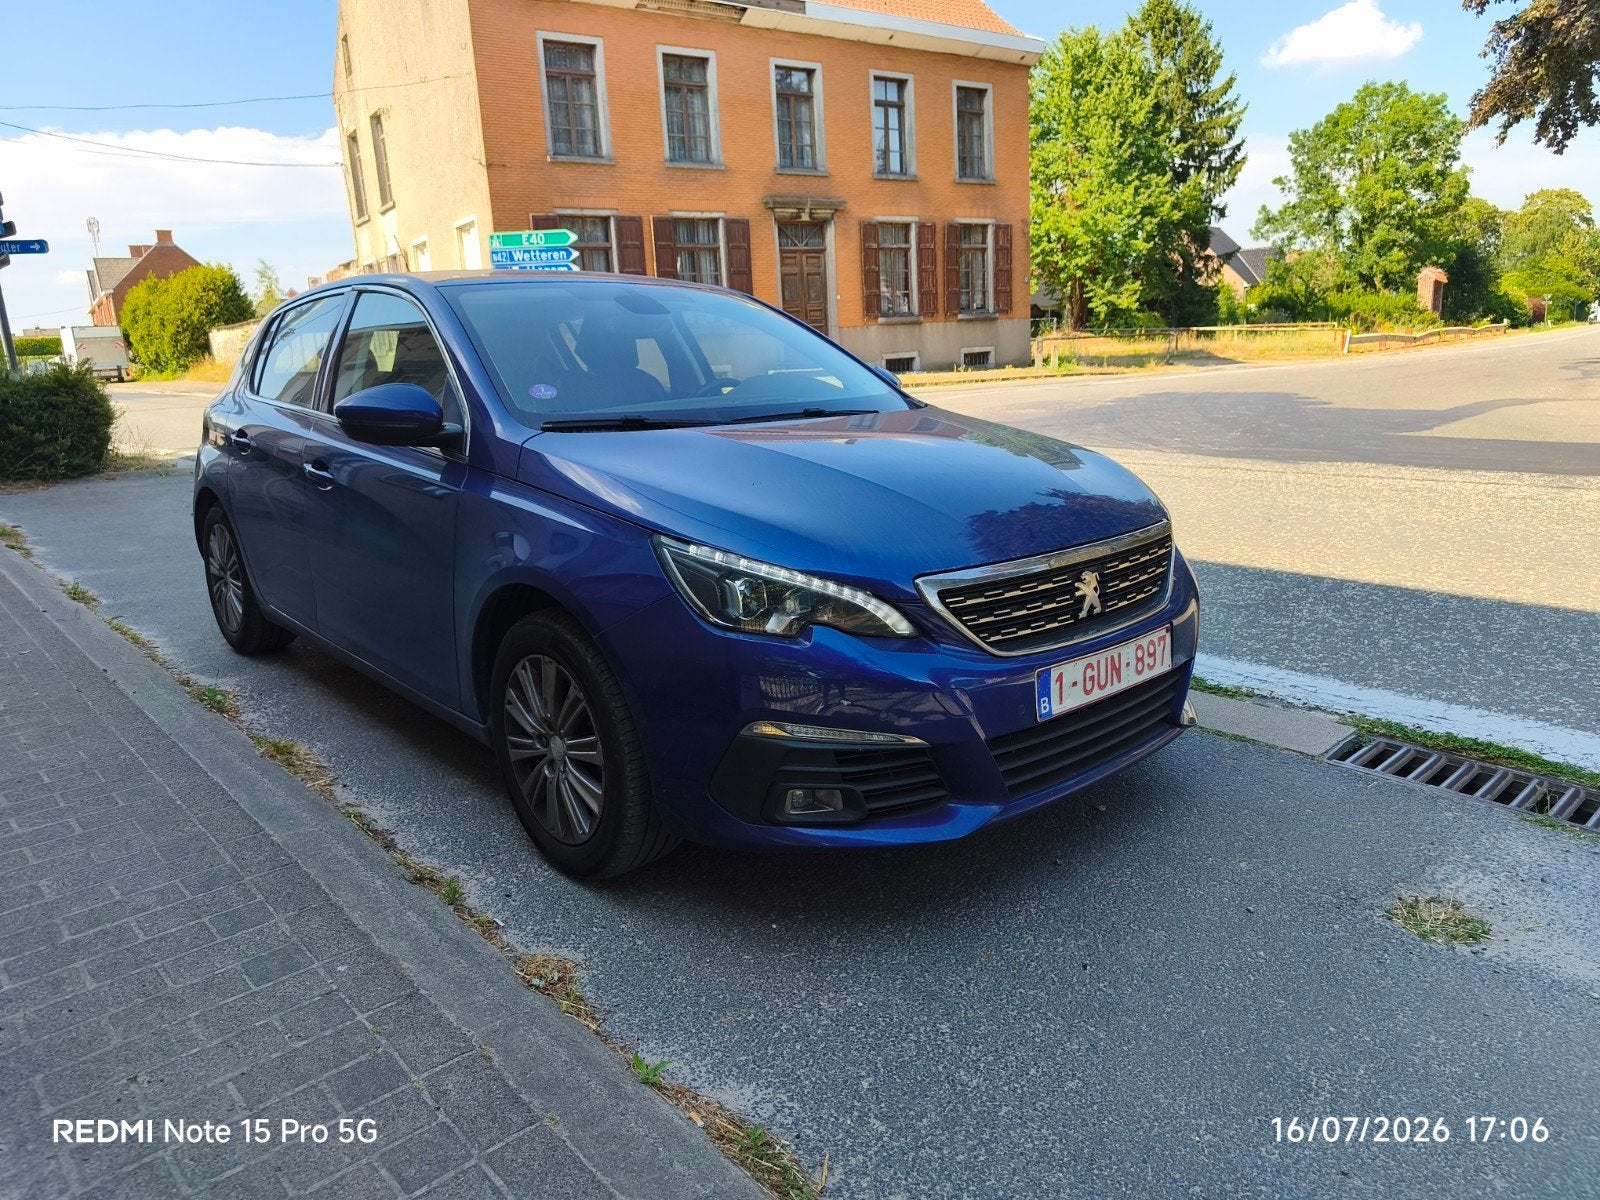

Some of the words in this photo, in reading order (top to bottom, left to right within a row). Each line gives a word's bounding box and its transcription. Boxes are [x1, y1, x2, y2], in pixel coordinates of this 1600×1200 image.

[521, 233, 546, 246] E40
[512, 250, 567, 261] Wetteren
[1040, 697, 1050, 714] B
[1055, 635, 1167, 705] 1-GUN-897
